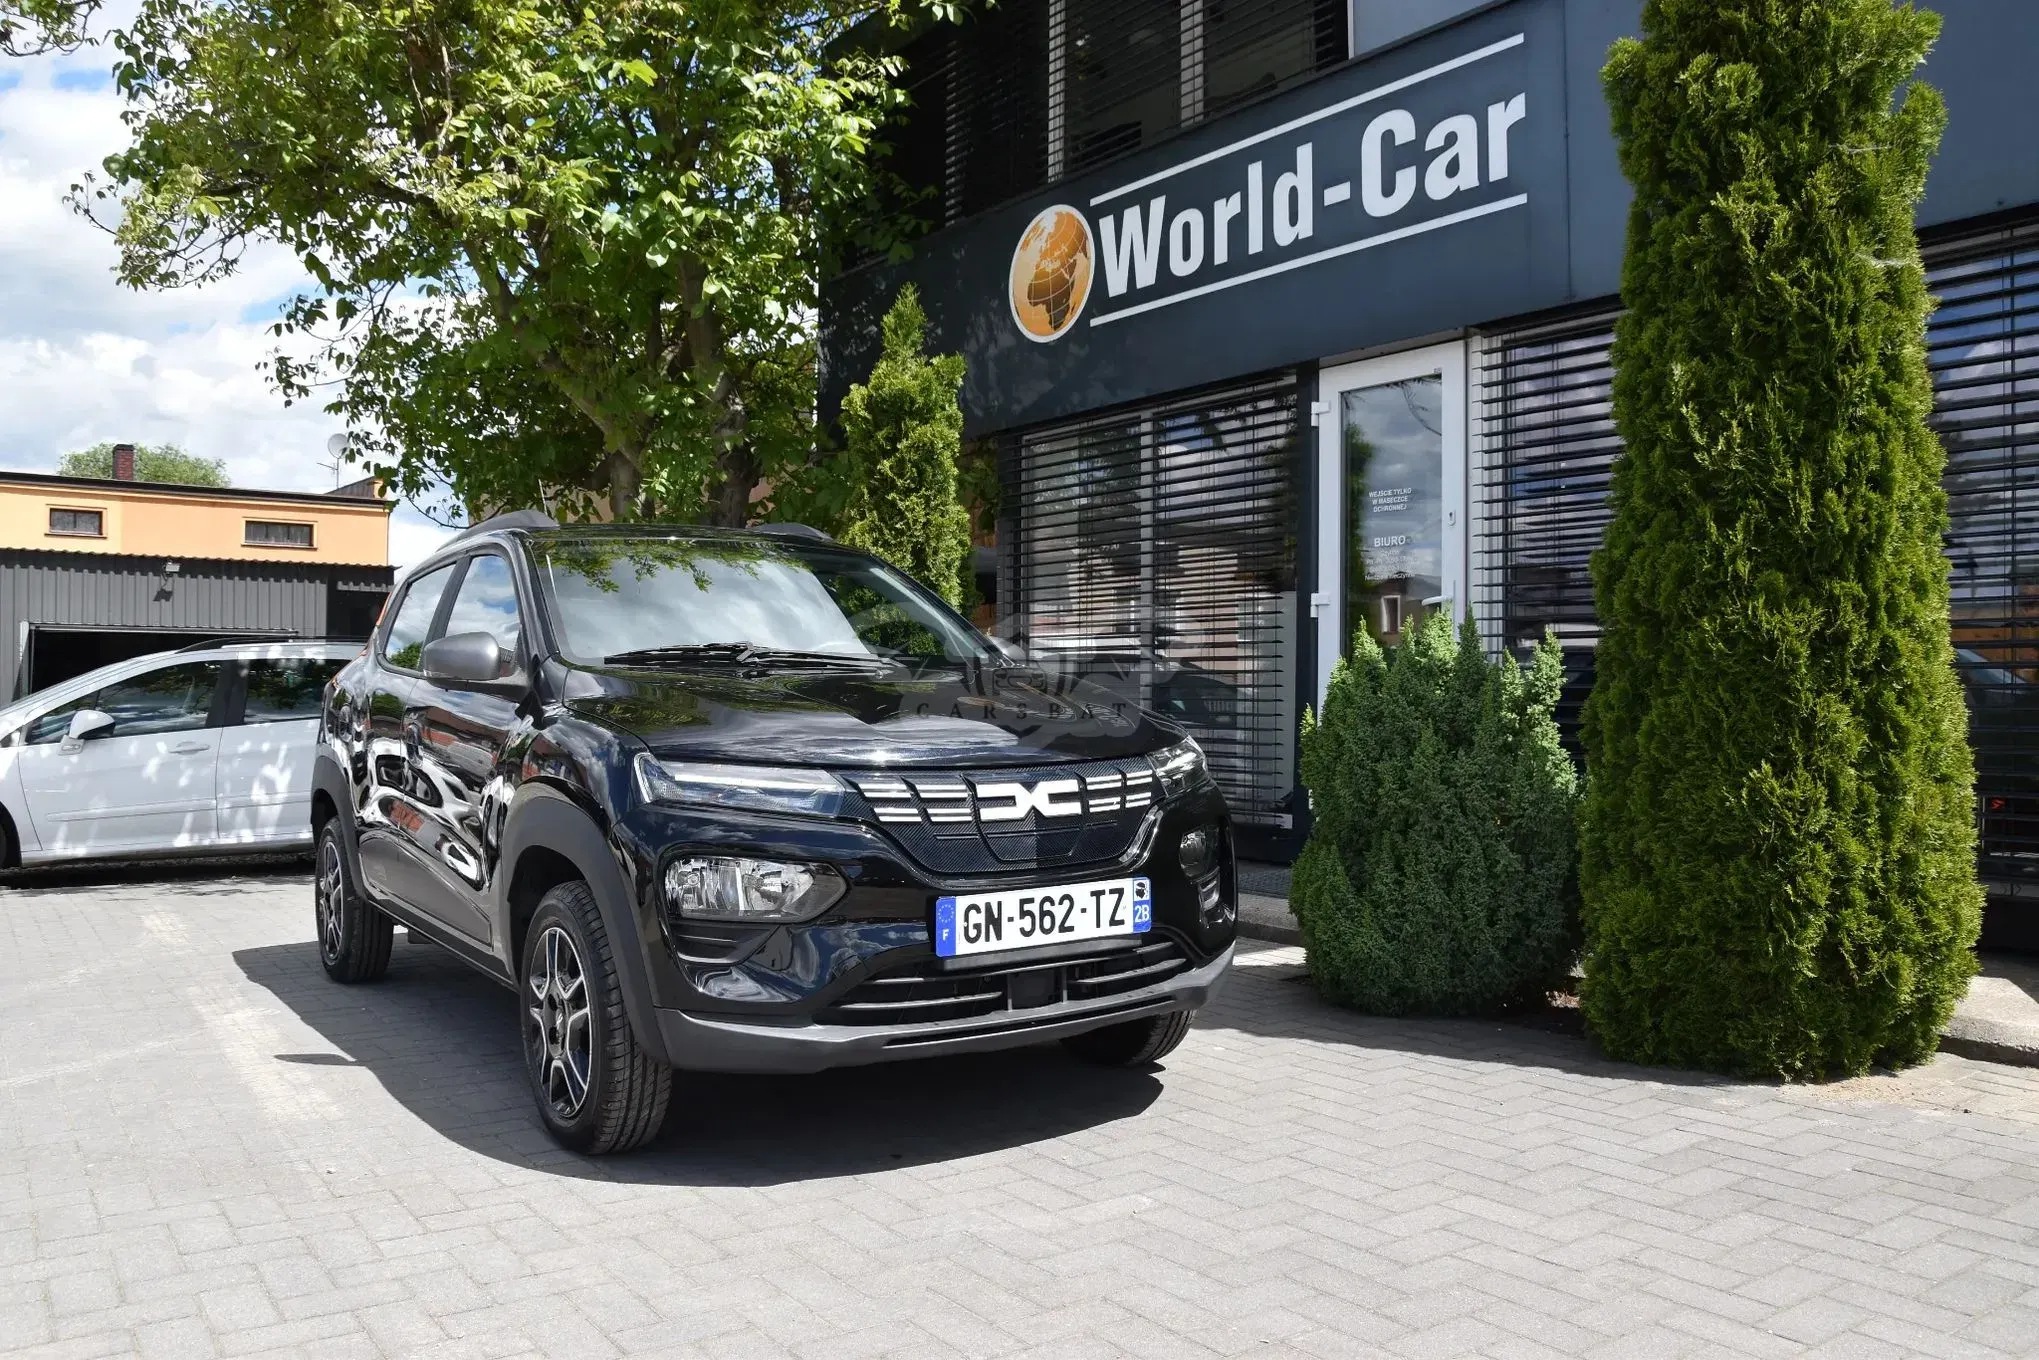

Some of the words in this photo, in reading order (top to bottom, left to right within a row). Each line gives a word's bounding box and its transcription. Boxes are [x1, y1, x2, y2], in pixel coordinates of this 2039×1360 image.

[1098, 92, 1526, 298] World-Car
[1374, 536, 1405, 547] BIURO
[942, 928, 949, 941] F
[963, 887, 1126, 944] GN-562-TZ
[1134, 904, 1150, 924] 2B
